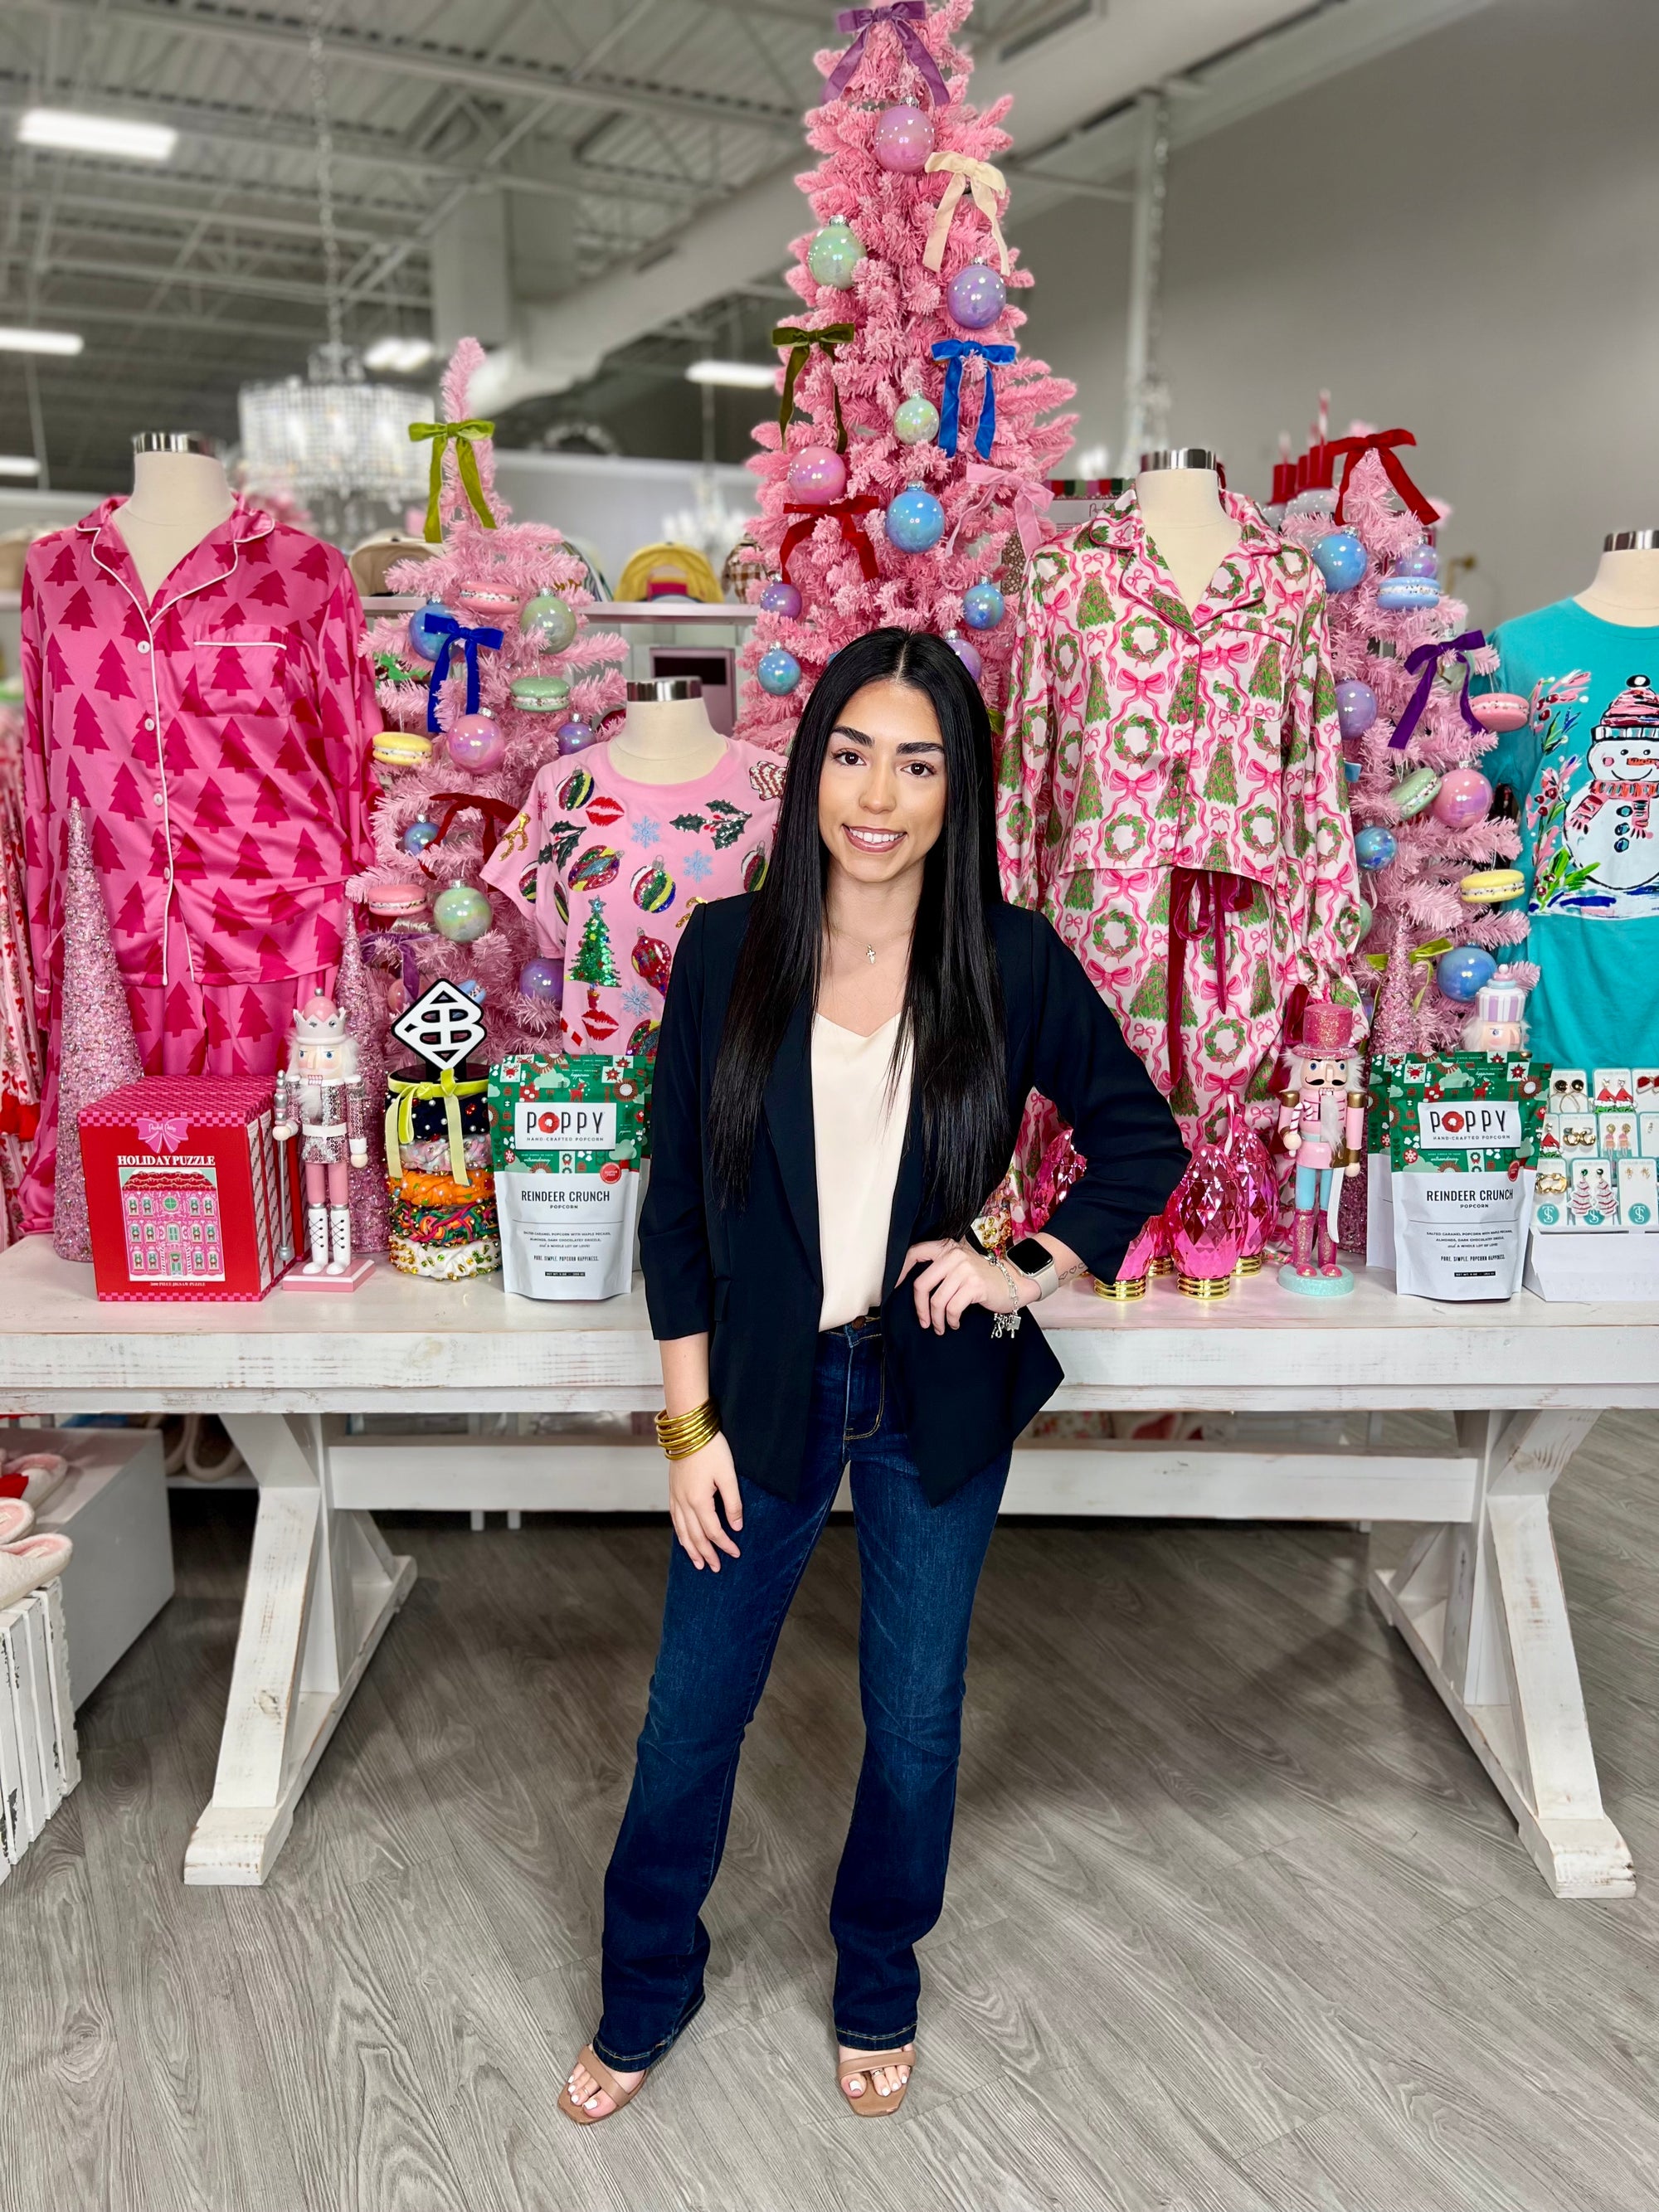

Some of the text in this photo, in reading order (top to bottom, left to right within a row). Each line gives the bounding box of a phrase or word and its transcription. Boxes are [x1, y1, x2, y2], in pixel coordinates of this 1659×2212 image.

[117, 1155, 215, 1166] HOLIDAY PUZZLE
[521, 1191, 610, 1201] REINDEER CRUNCH
[1427, 1189, 1513, 1201] REINDEER CRUNCH
